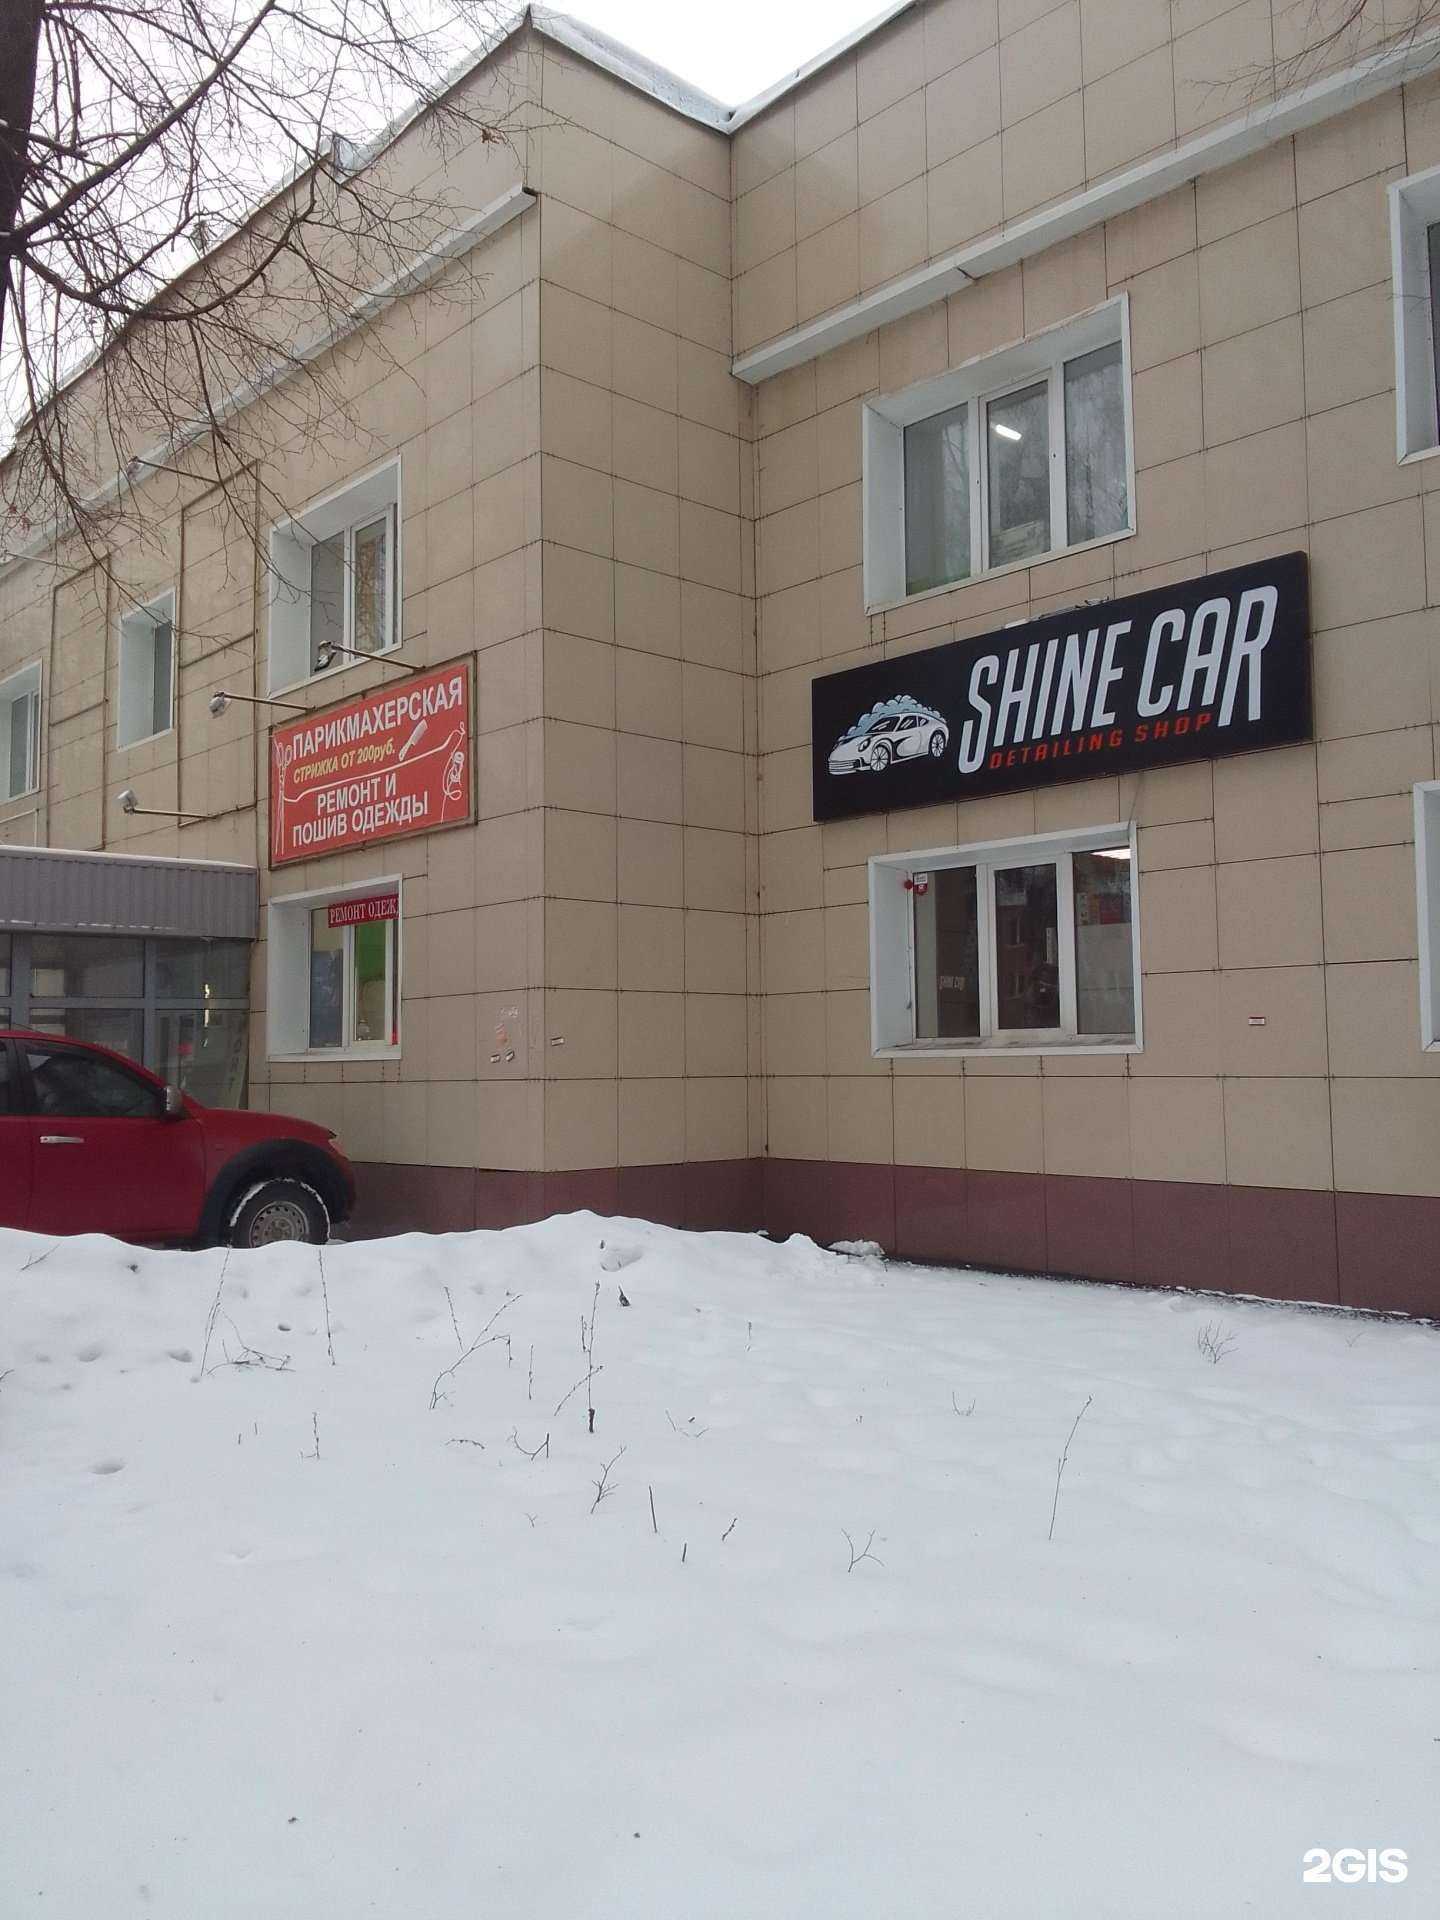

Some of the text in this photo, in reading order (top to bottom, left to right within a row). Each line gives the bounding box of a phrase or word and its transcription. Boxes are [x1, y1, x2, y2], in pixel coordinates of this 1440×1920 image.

[958, 585, 1278, 774] SHINE CAR
[293, 677, 463, 760] ПАРИКМАХЕРСКАЯ
[988, 712, 1213, 769] DETAILING SHOP
[293, 756, 339, 784] СТРИЖКА
[341, 750, 356, 769] ОТ
[317, 772, 397, 816] РЕМОНТ И
[293, 791, 428, 847] ПОШИВ ОДЕЖДЫ
[330, 898, 399, 924] РЕМОНТ ОДЕЖ
